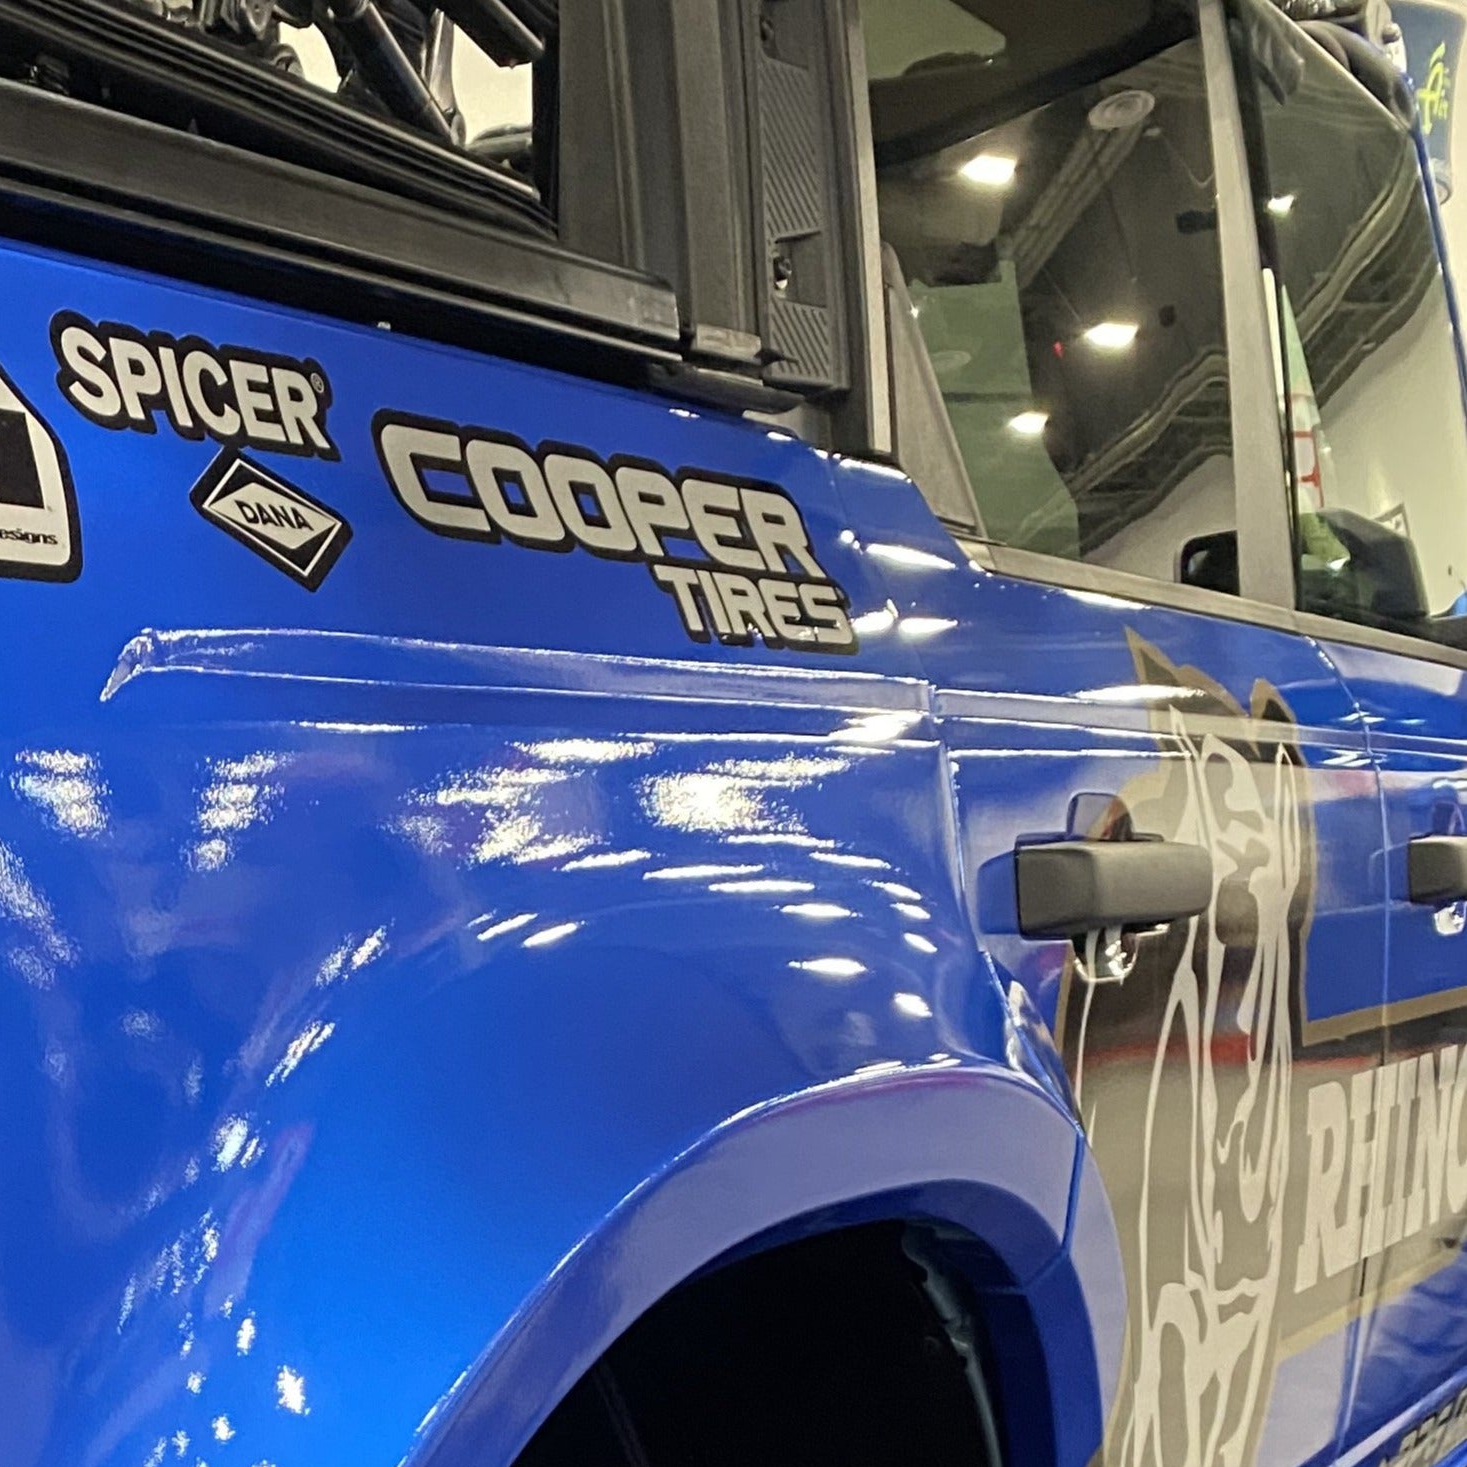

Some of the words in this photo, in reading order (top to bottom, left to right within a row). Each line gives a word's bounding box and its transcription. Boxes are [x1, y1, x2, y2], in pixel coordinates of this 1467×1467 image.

[235, 496, 314, 532] DANA
[381, 423, 826, 577] COOPER
[655, 565, 853, 645] TIRES
